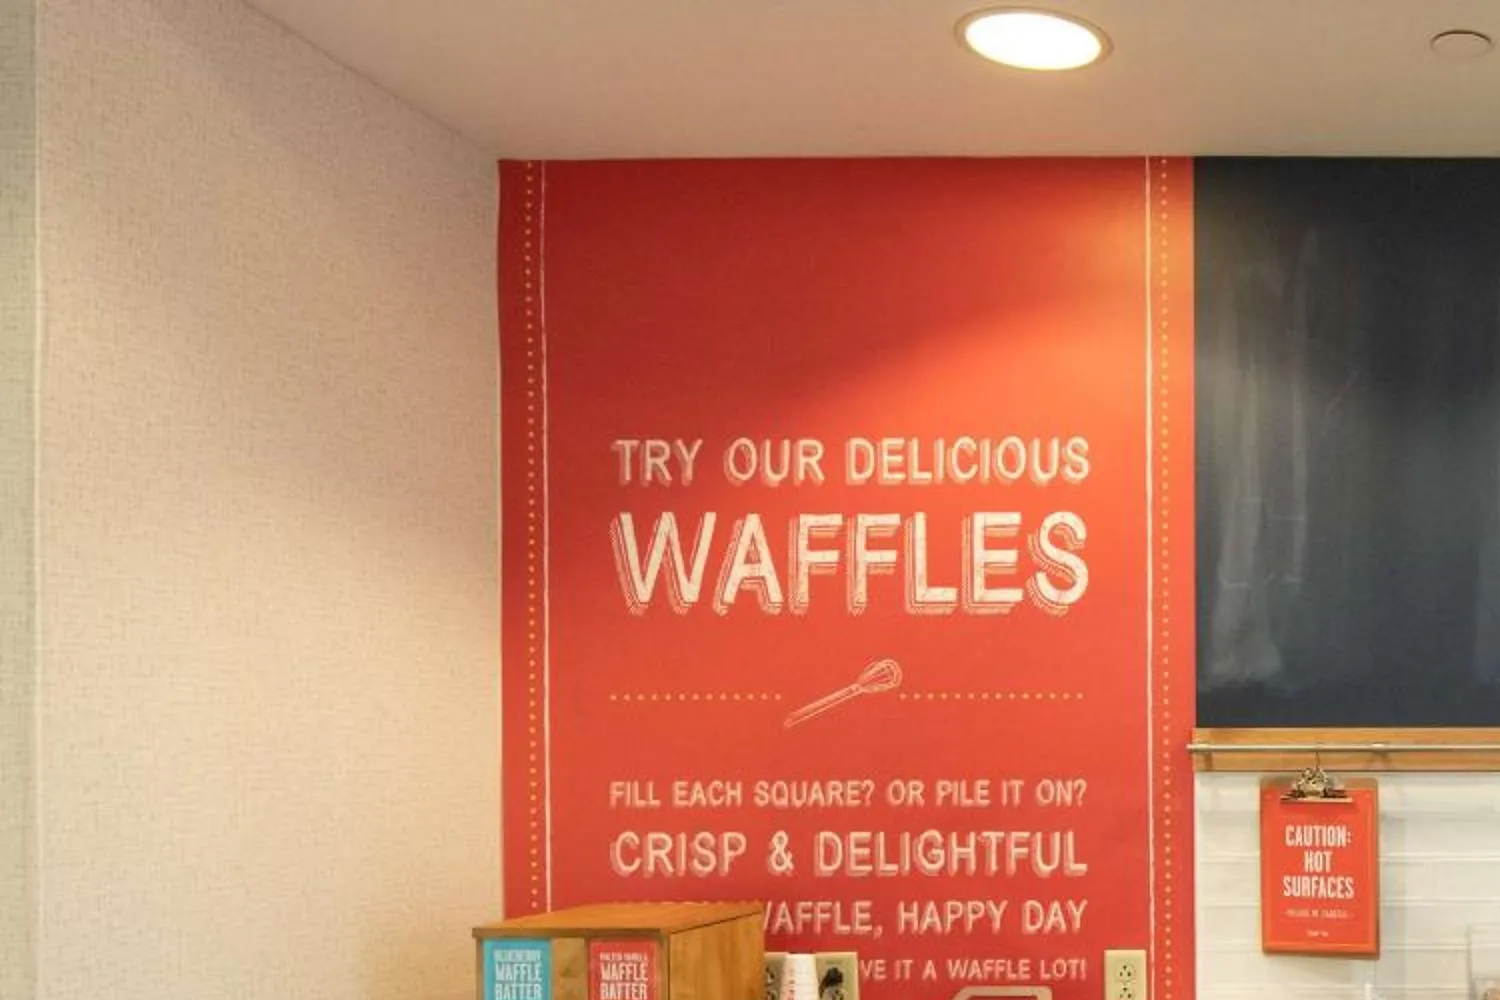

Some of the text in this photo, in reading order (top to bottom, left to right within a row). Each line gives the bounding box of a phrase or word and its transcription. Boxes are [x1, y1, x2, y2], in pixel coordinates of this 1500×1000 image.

[610, 435, 1089, 487] TRY OUR DELICIOUS
[610, 511, 1089, 615] WAFFLES
[609, 778, 1087, 808] FILL EACH SQUARE? OR PILE IT ON?
[1285, 825, 1352, 848] CAUTION:
[609, 830, 1088, 879] CRISP & DELIGHTFUL
[1304, 851, 1333, 873] HOT
[1283, 875, 1354, 899] SURFACES
[898, 900, 1007, 935] HAPPY
[1022, 899, 1089, 935] DAY
[495, 962, 543, 982] WAFFLE
[600, 962, 648, 981] WAFFLE
[860, 959, 1087, 981] VE IT A WAFFLE LOT!
[495, 983, 543, 1000] BATTER
[599, 982, 648, 1000] BATTER
